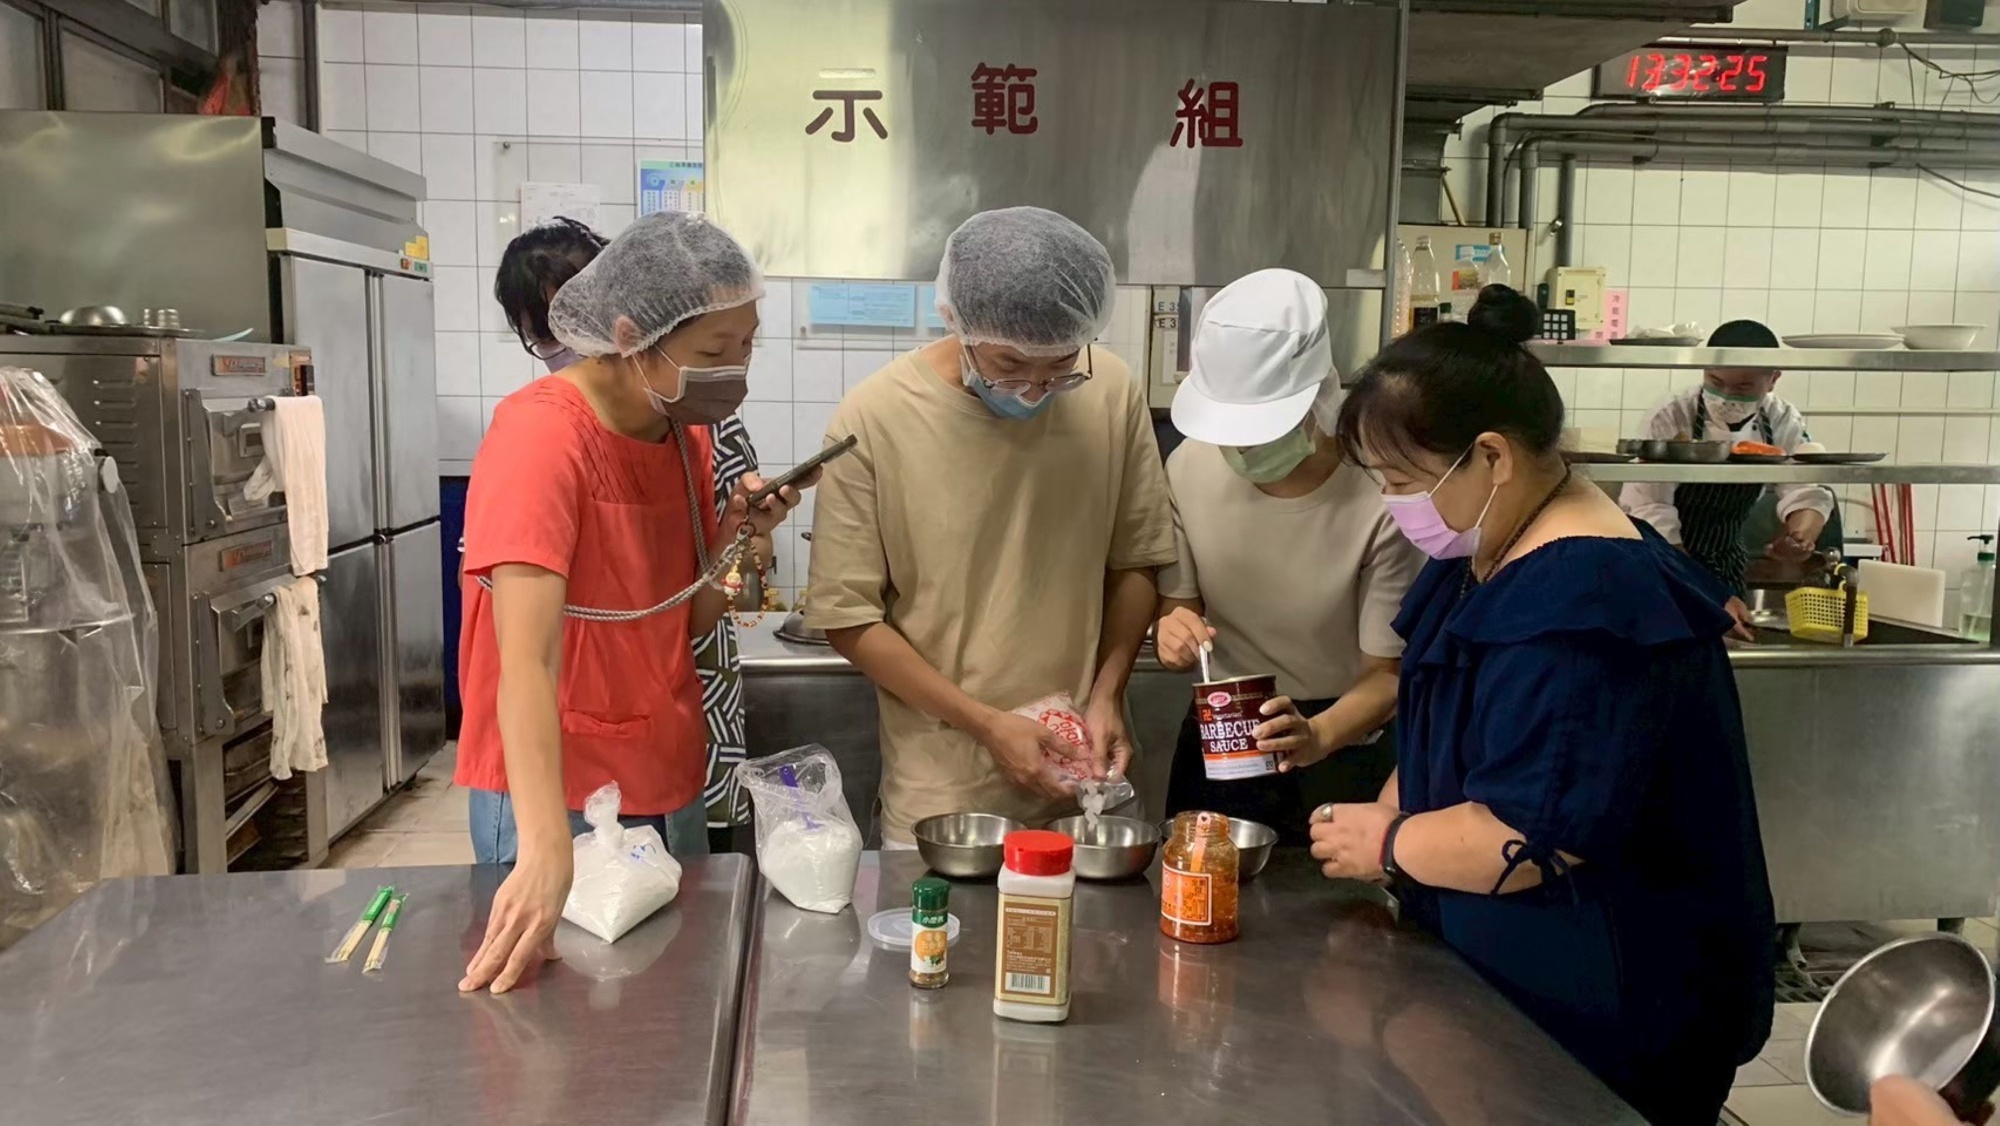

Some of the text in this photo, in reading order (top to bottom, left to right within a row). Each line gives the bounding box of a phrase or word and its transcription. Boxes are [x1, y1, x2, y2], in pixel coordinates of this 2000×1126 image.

[804, 62, 1244, 148] 示範組
[1210, 738, 1248, 753] SAUCE
